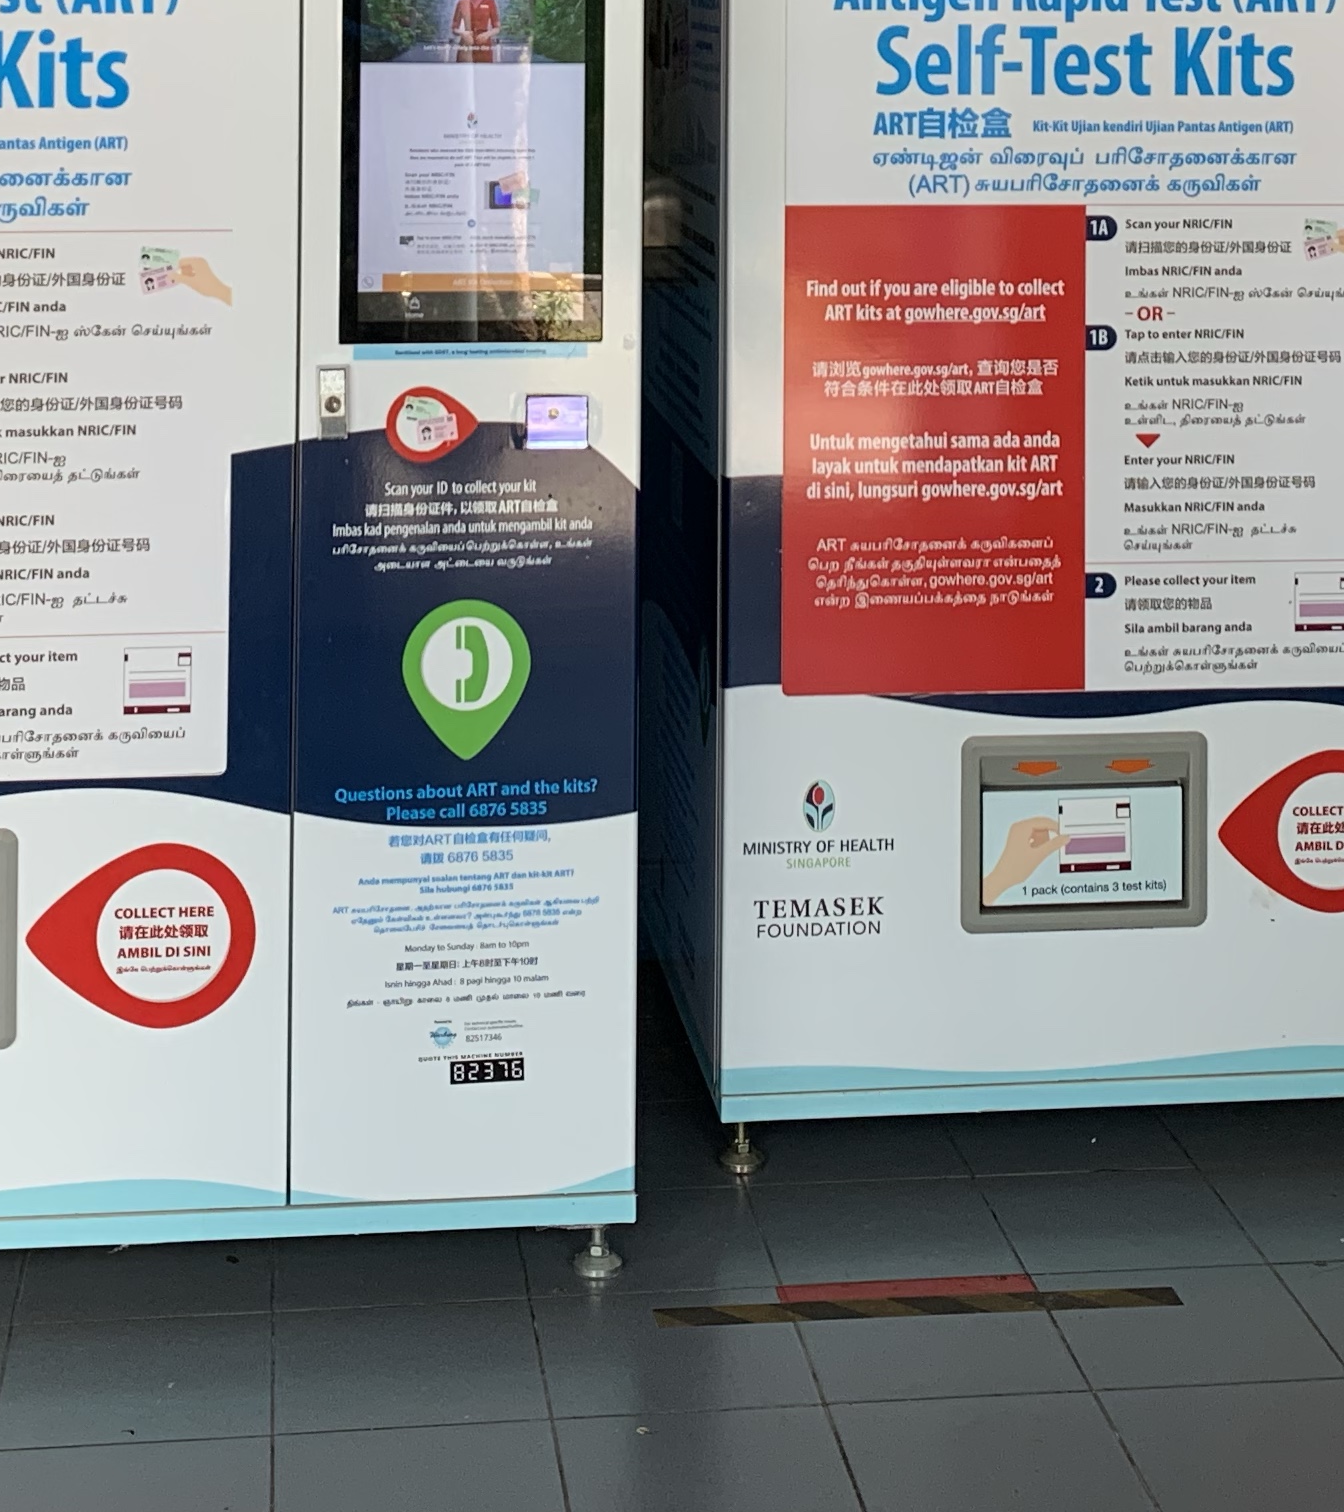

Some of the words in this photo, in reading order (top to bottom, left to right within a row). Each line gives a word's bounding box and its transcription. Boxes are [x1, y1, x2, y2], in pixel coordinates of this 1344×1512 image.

[876, 24, 1152, 96] Self-Test
[1175, 26, 1294, 96] Kits
[871, 106, 1014, 140] ART自检盒
[39, 137, 91, 152] Antigen
[95, 136, 128, 151] (ART)
[9, 372, 68, 384] NRIC/FIN
[385, 482, 409, 496] Scan
[411, 485, 433, 499] your
[437, 482, 448, 495] ID
[452, 483, 463, 494] to
[465, 481, 497, 494] collect
[498, 483, 521, 498] your
[523, 479, 537, 492] kit
[14, 654, 45, 665] your
[48, 651, 77, 662] item
[335, 786, 412, 803] Questions
[417, 785, 462, 798] about
[466, 783, 497, 796] ART
[502, 780, 530, 795] and
[535, 780, 559, 794] the
[564, 779, 597, 793] kits?
[386, 806, 437, 822] Please
[440, 804, 467, 820] call
[470, 802, 507, 818] 6876
[510, 801, 547, 816] 5835
[115, 907, 175, 919] COLLECT
[179, 906, 214, 917] HERE
[754, 897, 883, 918] TEMASEK
[120, 925, 208, 939] 请在此处领取
[757, 921, 880, 938] FOUNDATION
[118, 947, 162, 958] AMBIL
[166, 947, 179, 957] DI
[184, 946, 210, 957] SINI
[466, 1033, 502, 1042] 82517346
[454, 1060, 522, 1082] 82376
